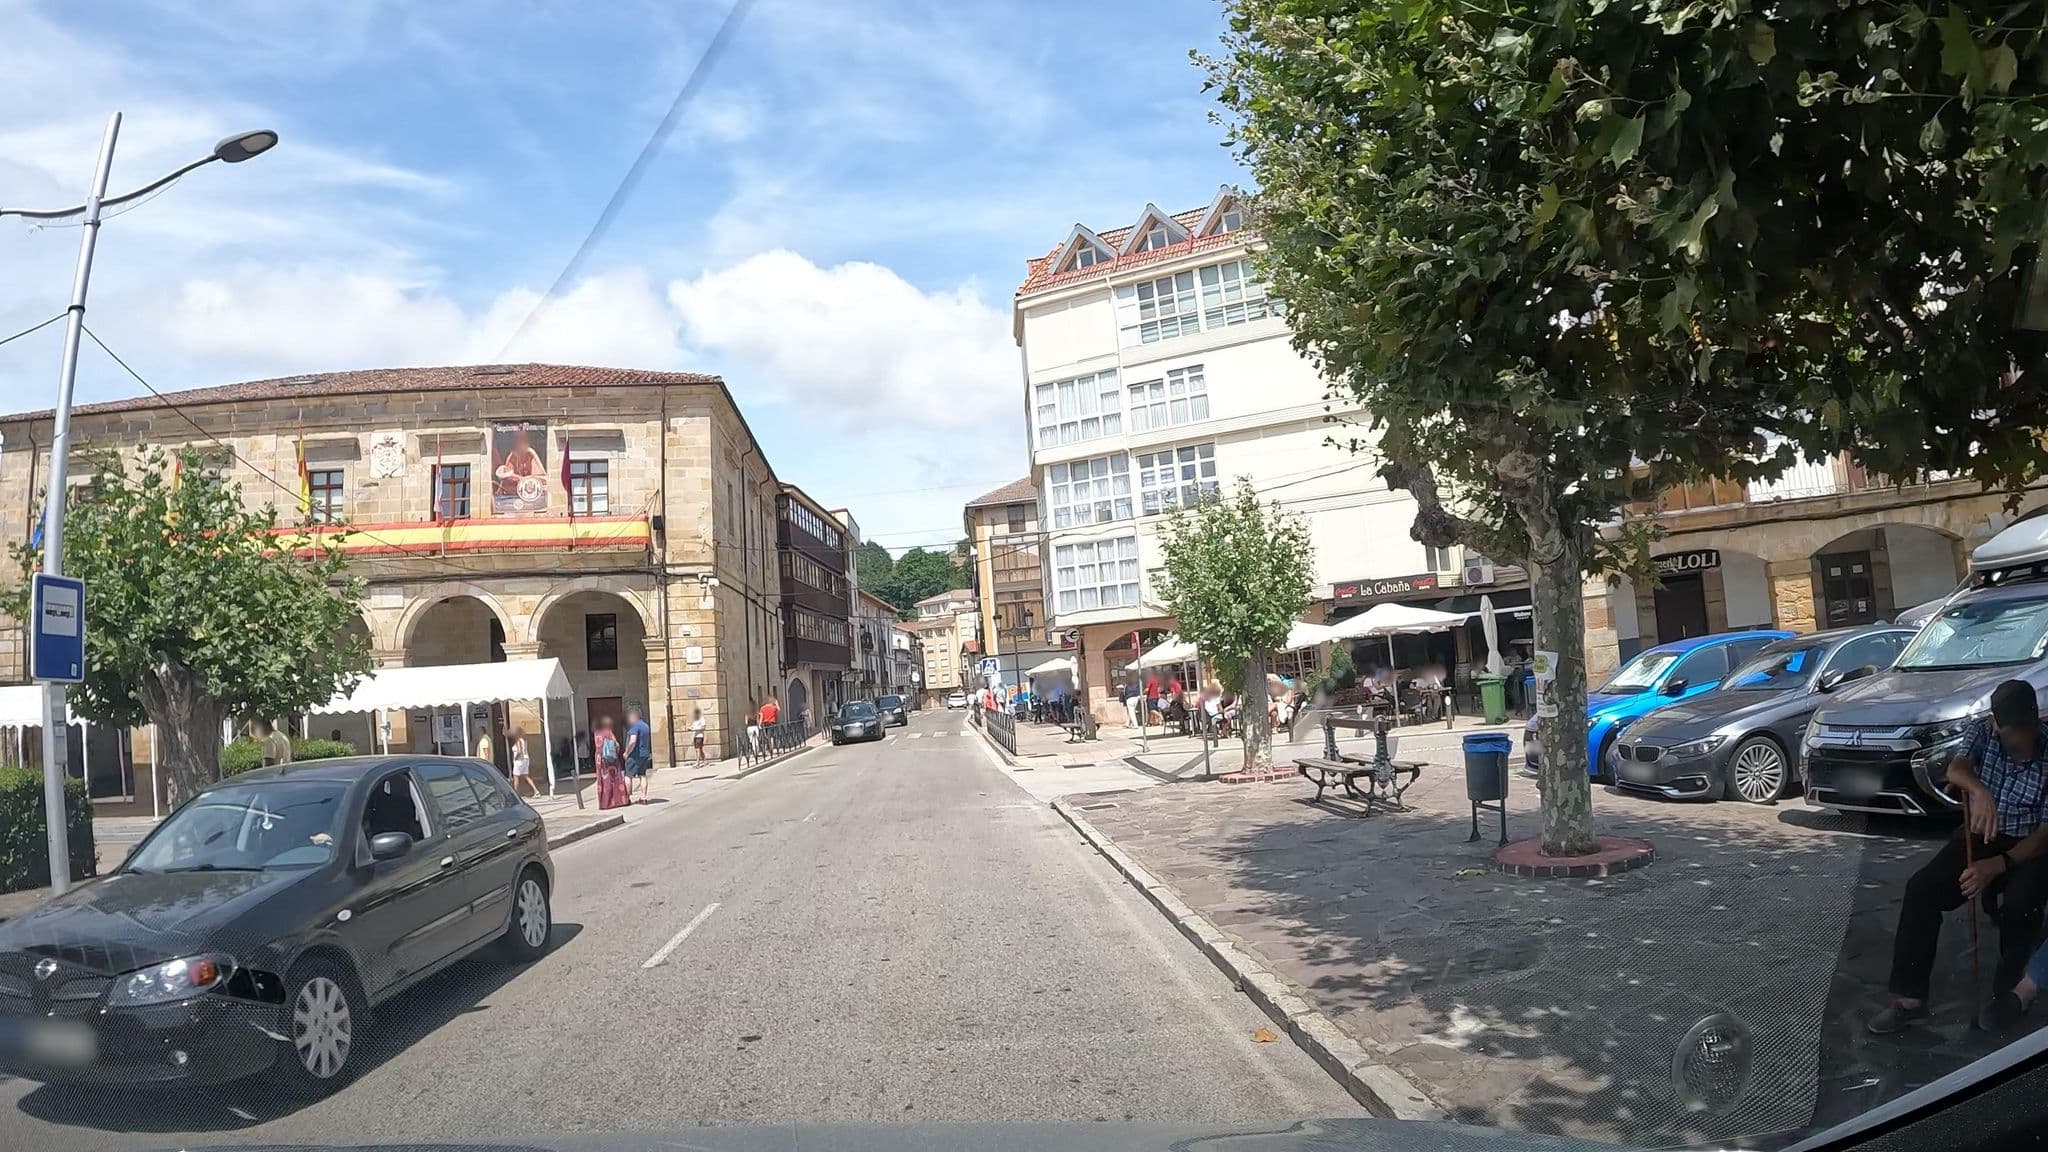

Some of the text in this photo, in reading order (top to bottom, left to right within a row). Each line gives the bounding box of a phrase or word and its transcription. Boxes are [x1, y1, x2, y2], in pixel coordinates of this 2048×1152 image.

[1678, 552, 1716, 569] LOLI
[1360, 584, 1372, 596] La
[1374, 581, 1410, 594] Cabaña
